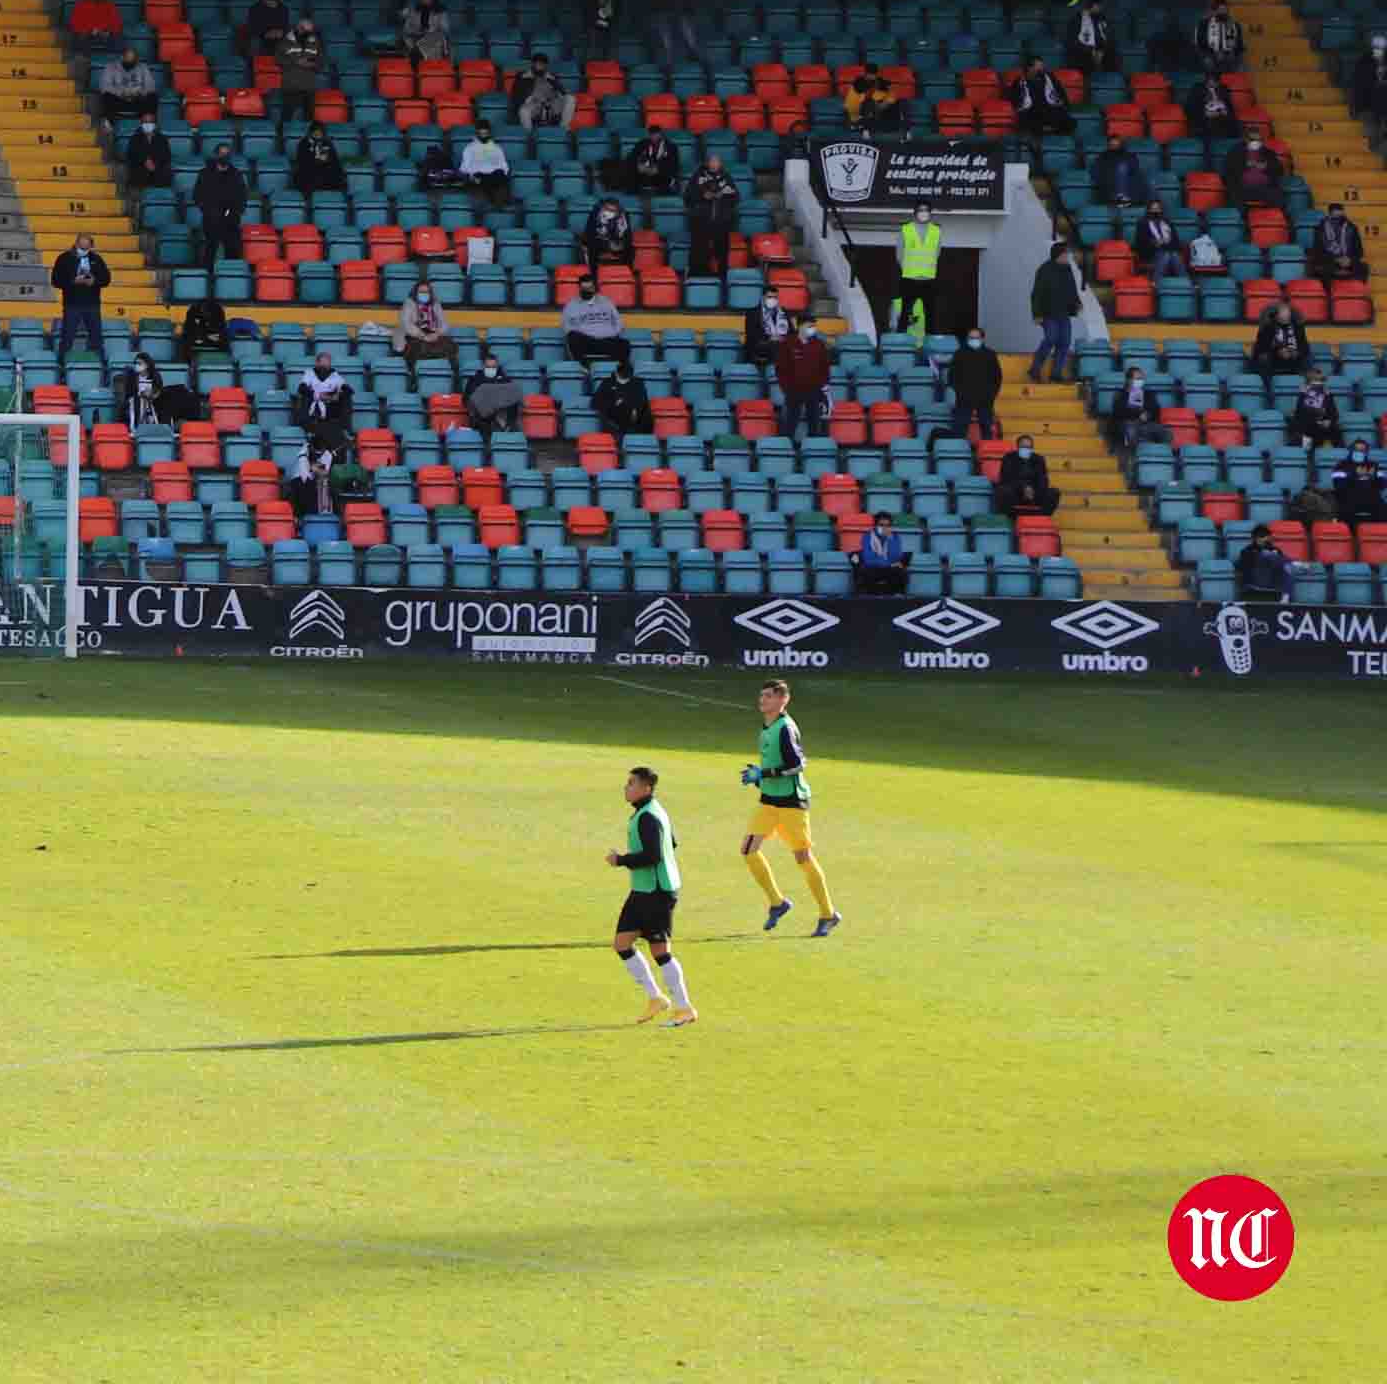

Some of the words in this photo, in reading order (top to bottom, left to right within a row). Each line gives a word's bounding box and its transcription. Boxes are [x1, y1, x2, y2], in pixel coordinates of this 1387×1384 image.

[385, 596, 599, 647] gruponani
[744, 647, 829, 668] umbro
[904, 648, 989, 670] umbro
[1061, 651, 1148, 672] umbro
